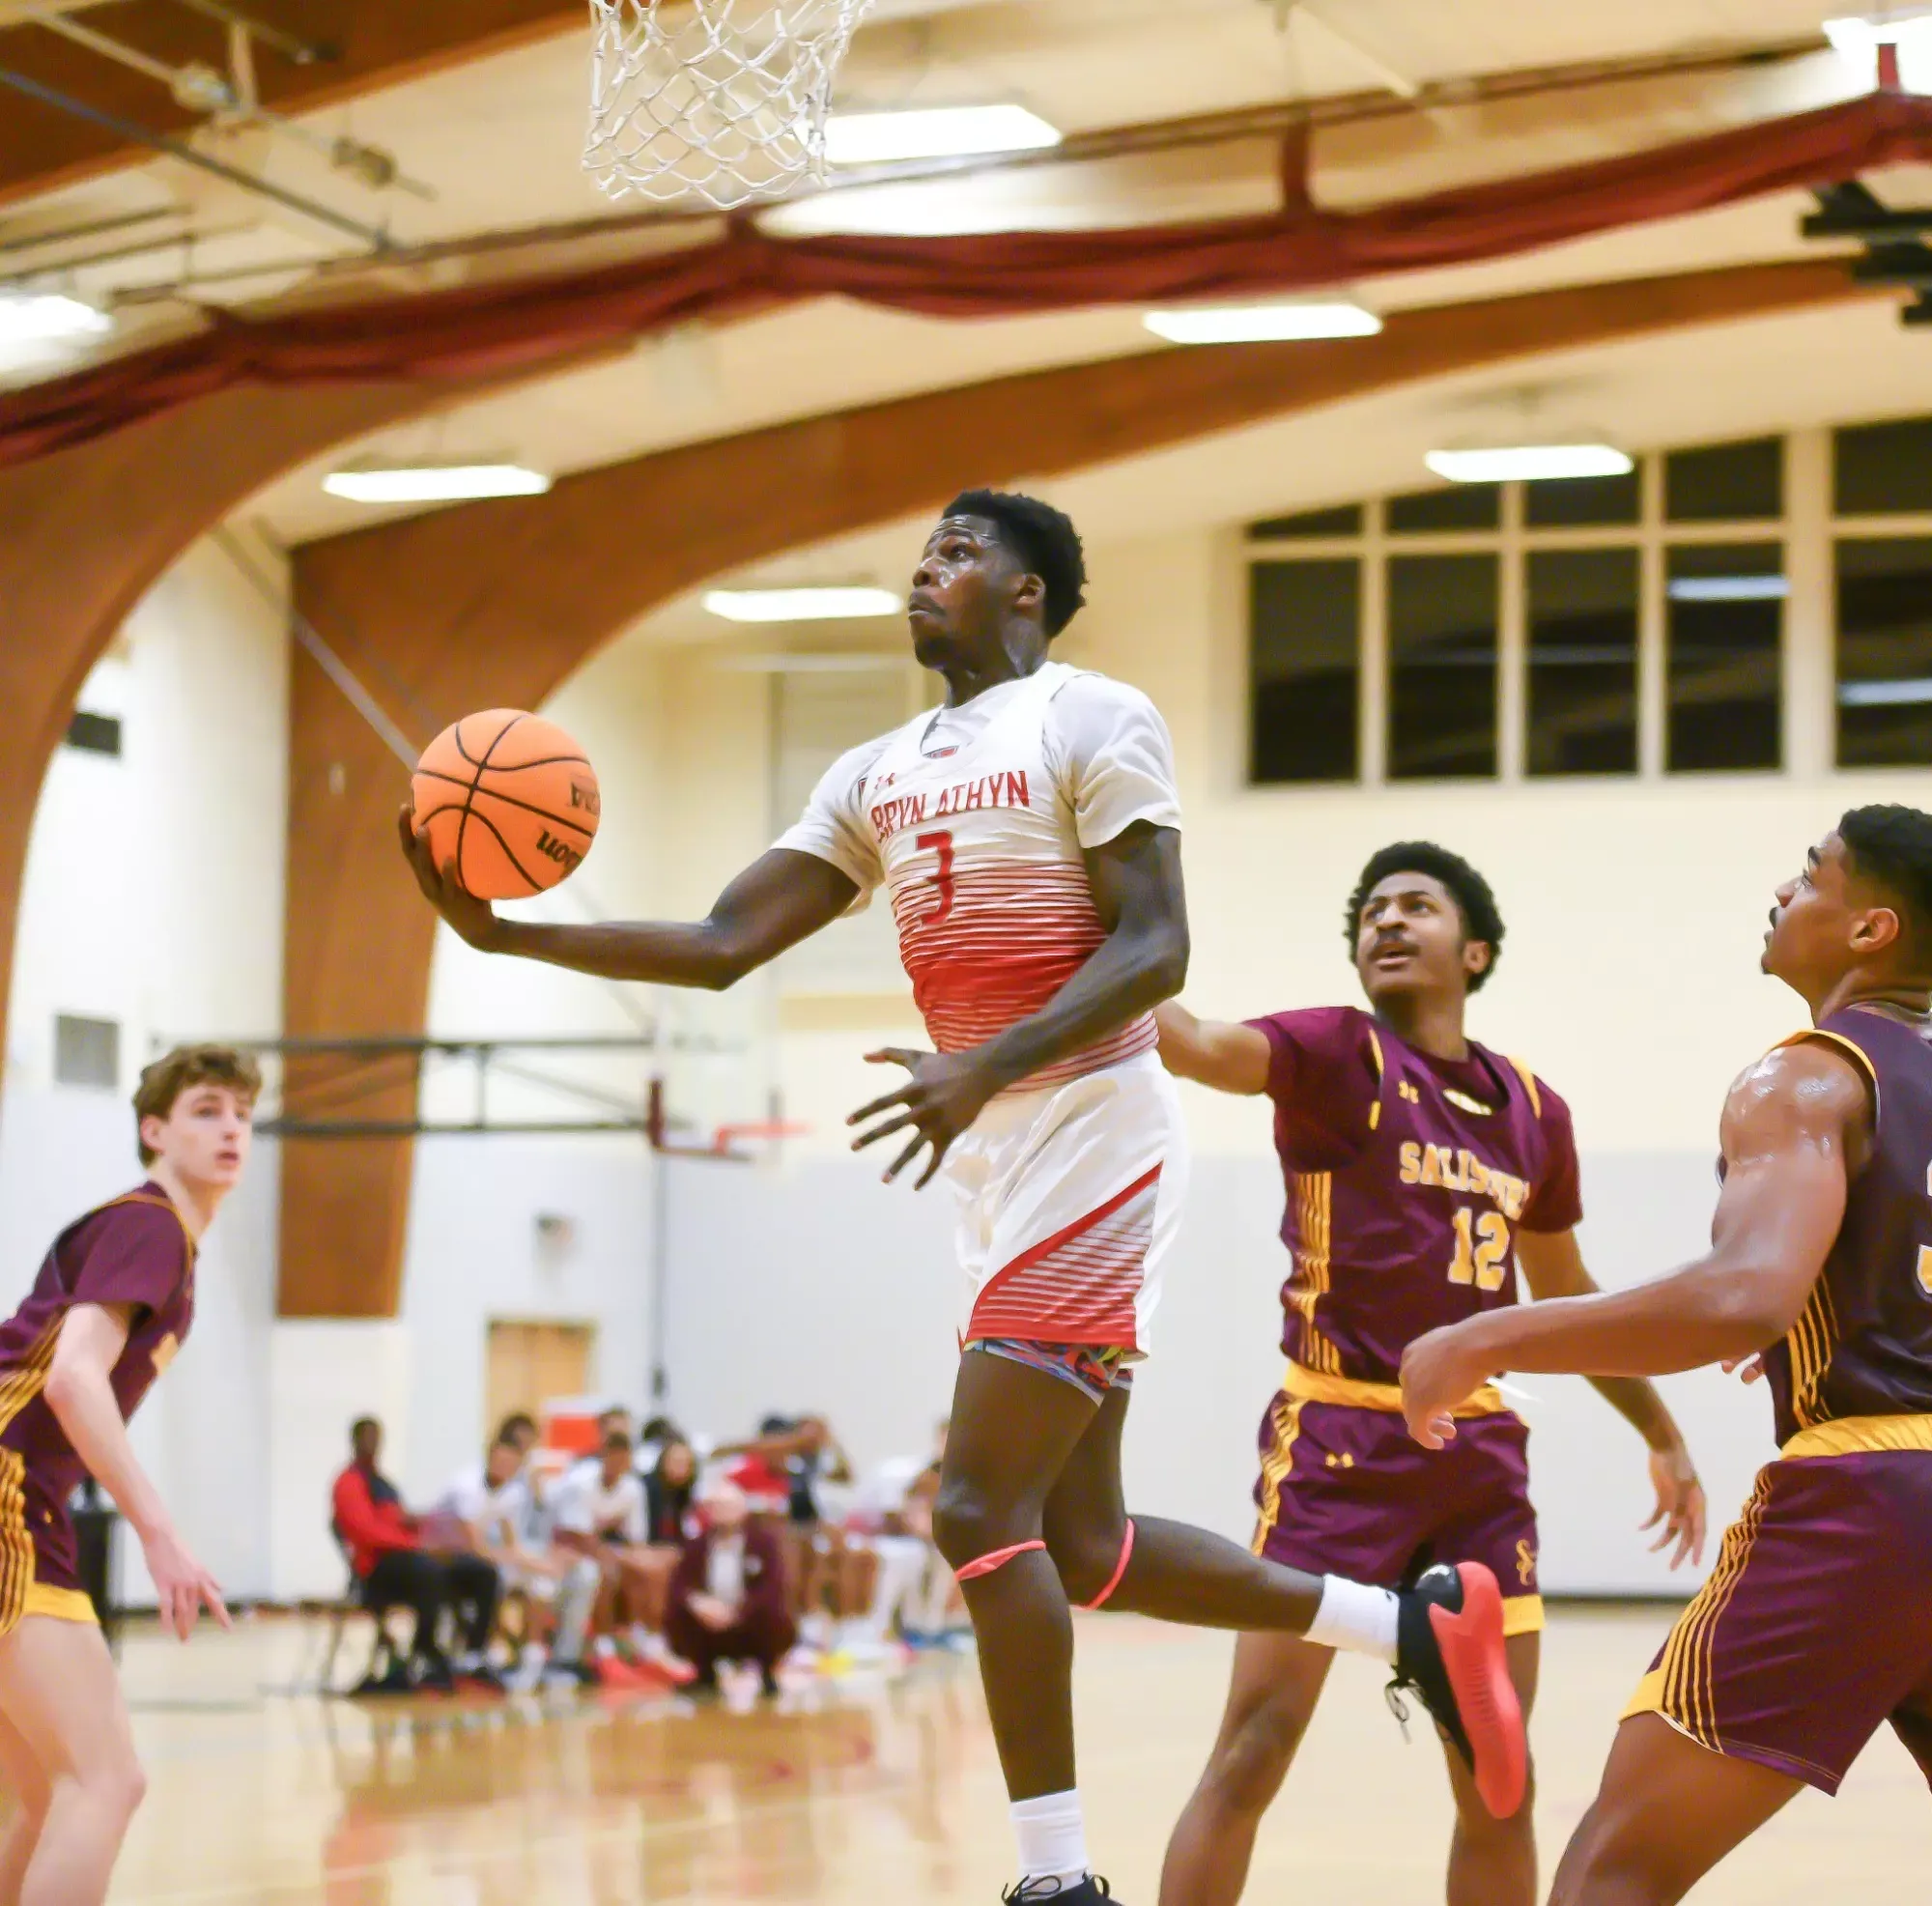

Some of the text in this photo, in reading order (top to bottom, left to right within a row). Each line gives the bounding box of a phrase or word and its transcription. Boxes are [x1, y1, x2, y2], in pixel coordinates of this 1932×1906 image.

[871, 770, 1031, 843] BRYN ATHYN
[915, 830, 954, 925] 3
[1400, 1141, 1530, 1222] SALIS
[1447, 1207, 1511, 1292] 12
